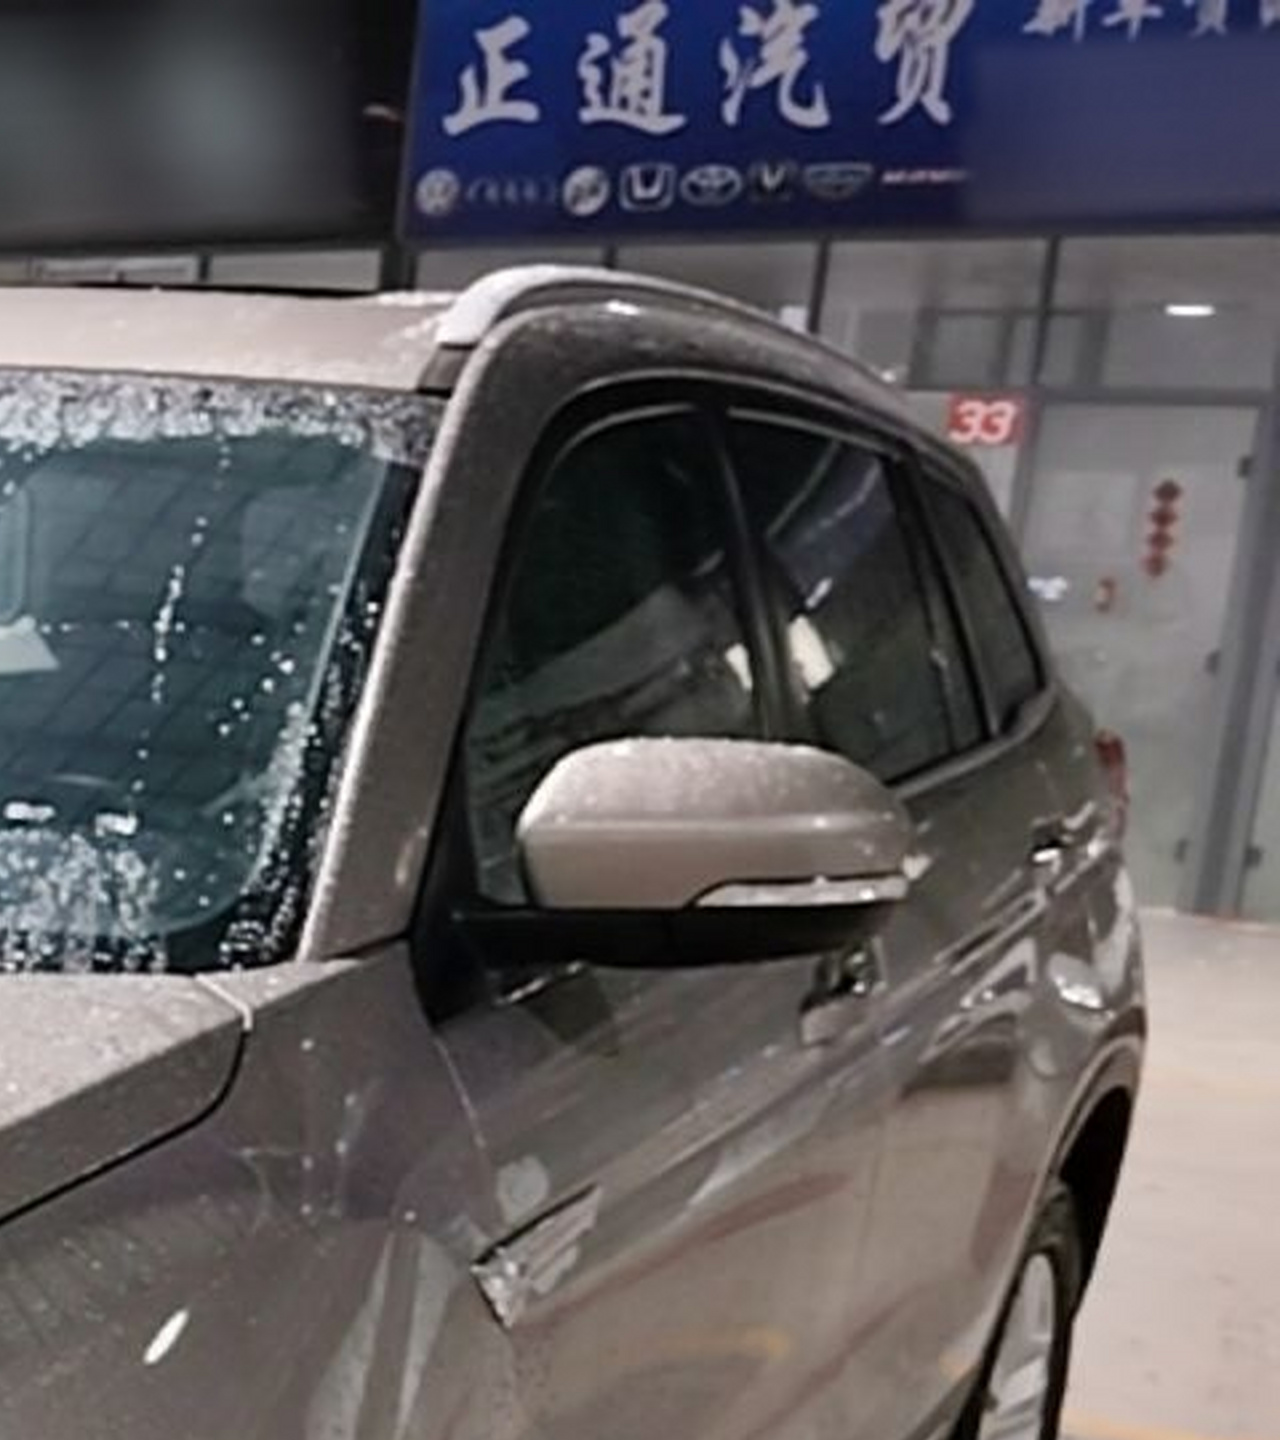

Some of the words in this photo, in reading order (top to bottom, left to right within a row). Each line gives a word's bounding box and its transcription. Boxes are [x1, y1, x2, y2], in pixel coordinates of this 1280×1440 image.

[442, 0, 976, 136] 正通汽贸
[949, 400, 1016, 443] 33
